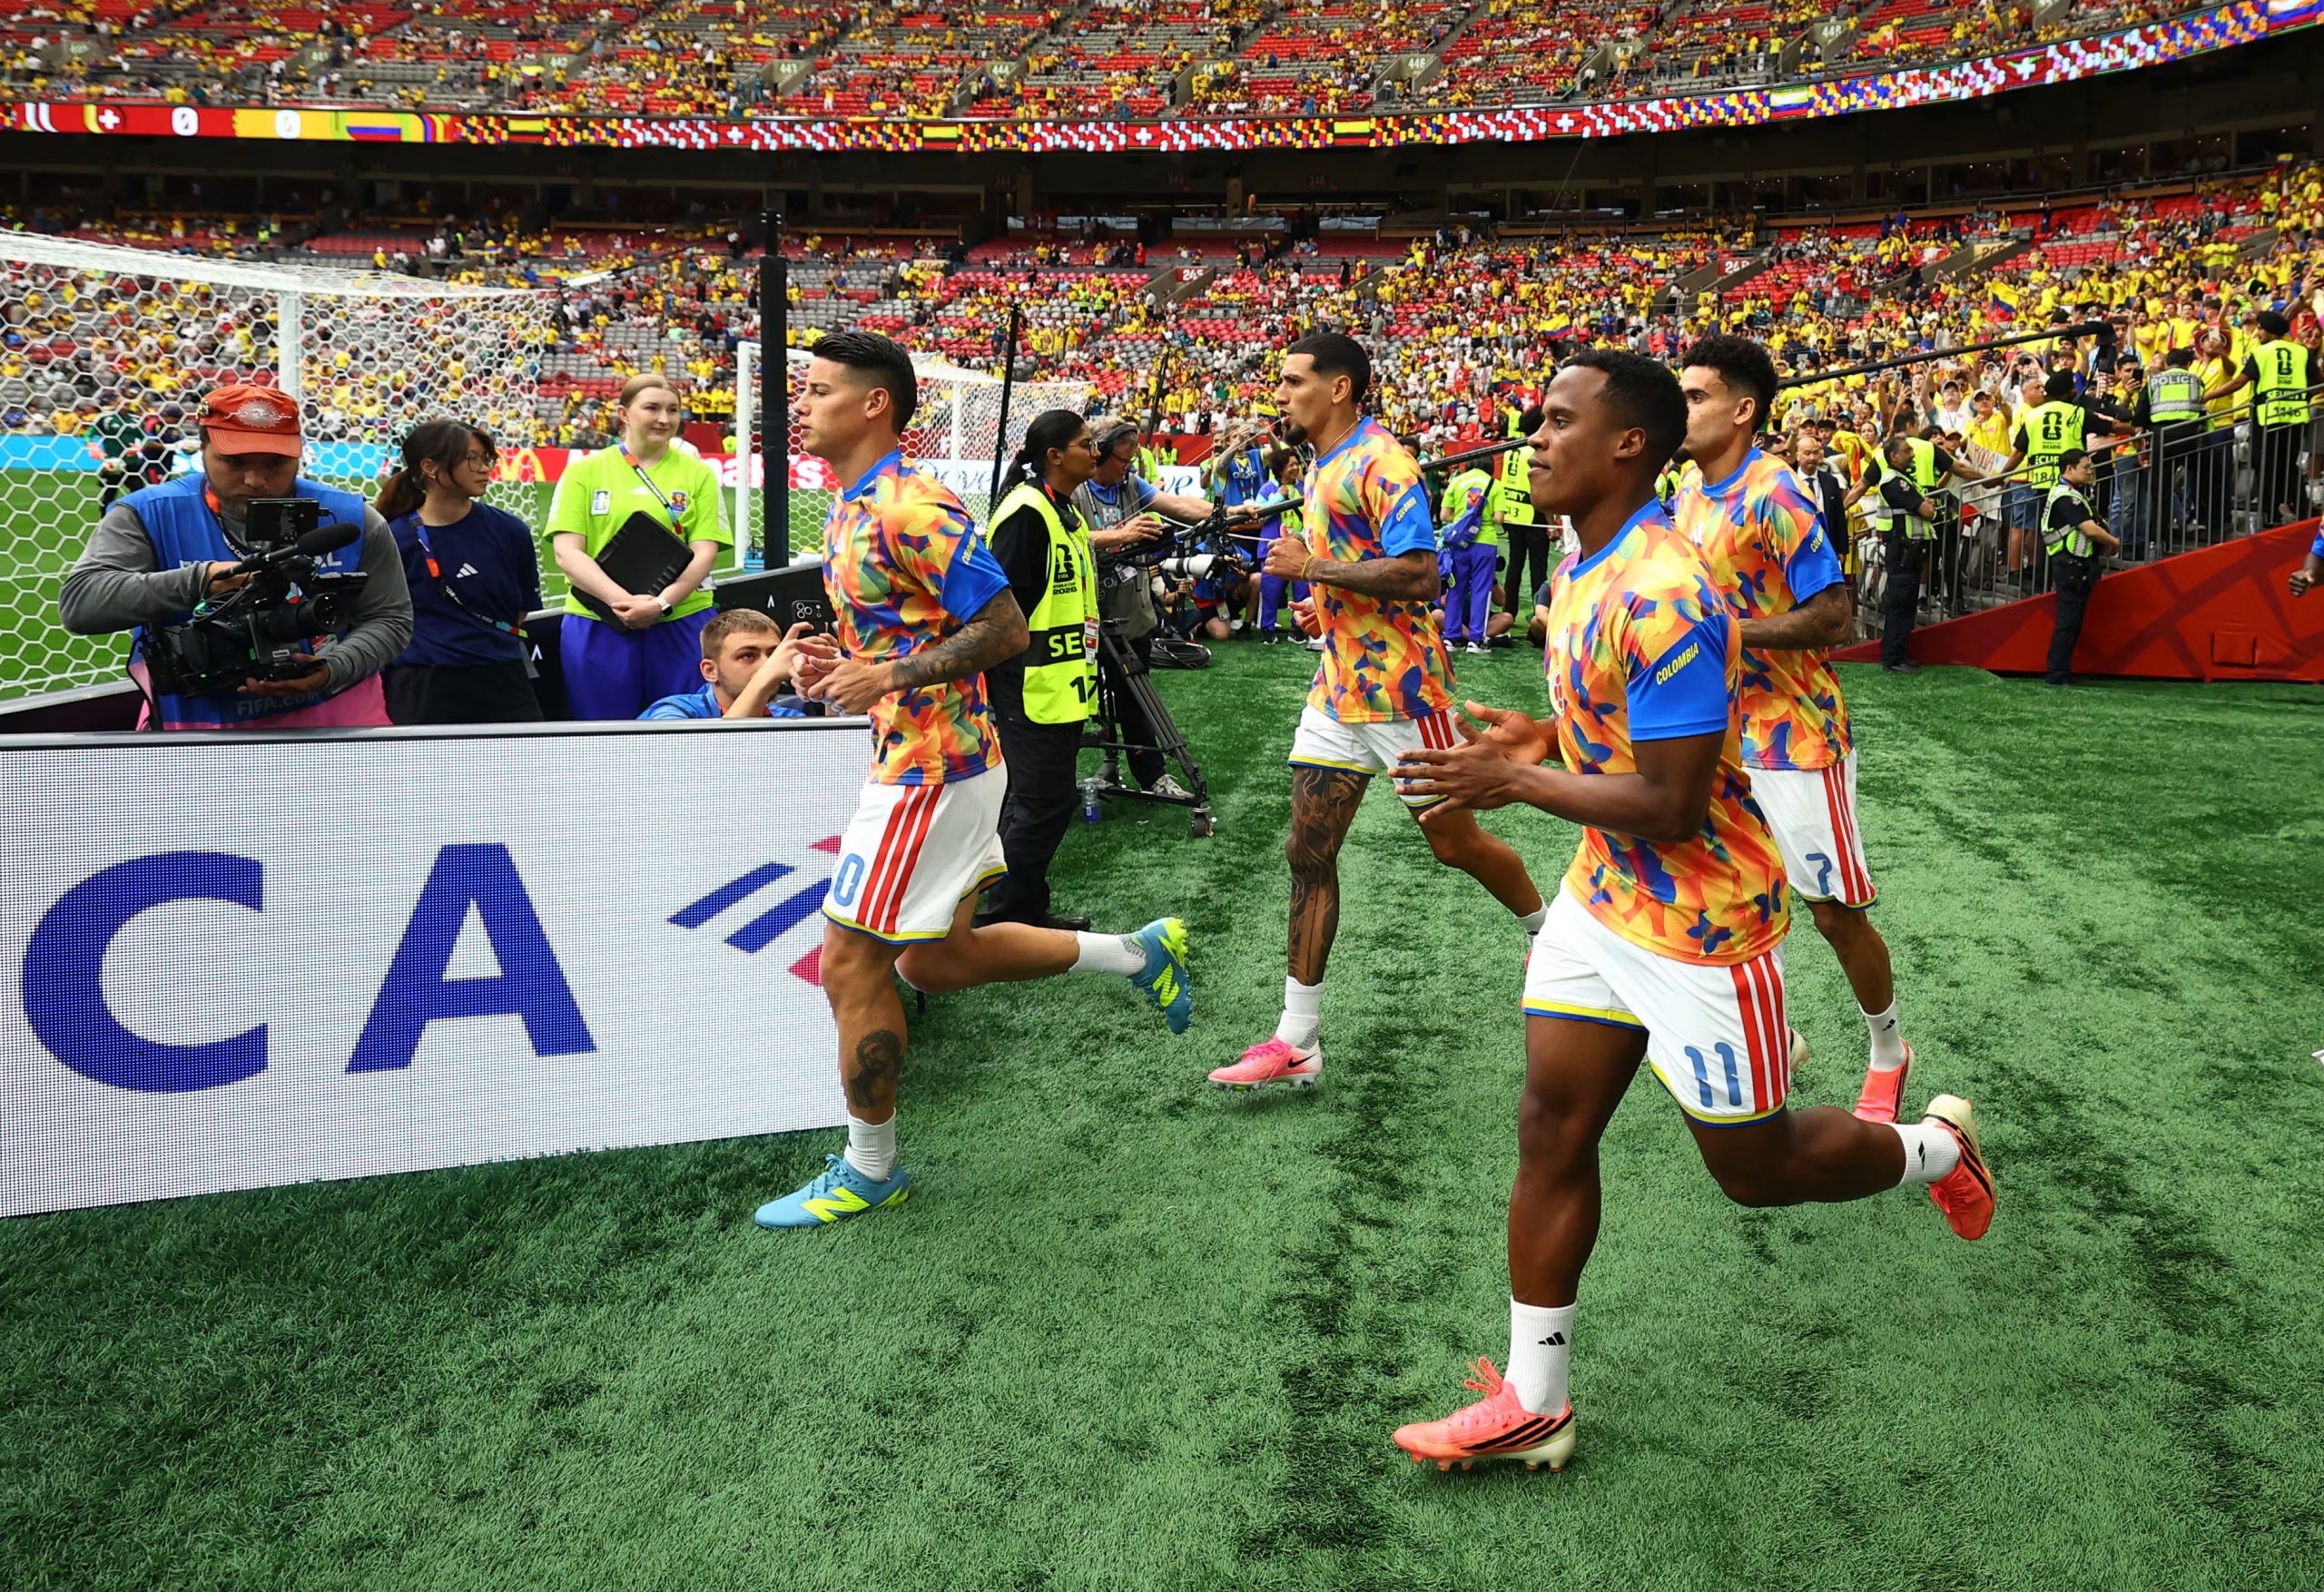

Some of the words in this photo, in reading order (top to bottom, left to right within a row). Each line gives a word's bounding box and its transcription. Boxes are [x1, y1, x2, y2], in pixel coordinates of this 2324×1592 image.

[1408, 57, 1426, 69] 446
[1615, 45, 1633, 58] 47
[992, 64, 1010, 75] 444
[172, 106, 199, 136] 0
[275, 109, 301, 139] 0
[1656, 642, 1699, 685] COLOMBIA
[237, 691, 320, 716] FIFA.com
[1806, 852, 1832, 896] 7
[1684, 1041, 1742, 1108] 11
